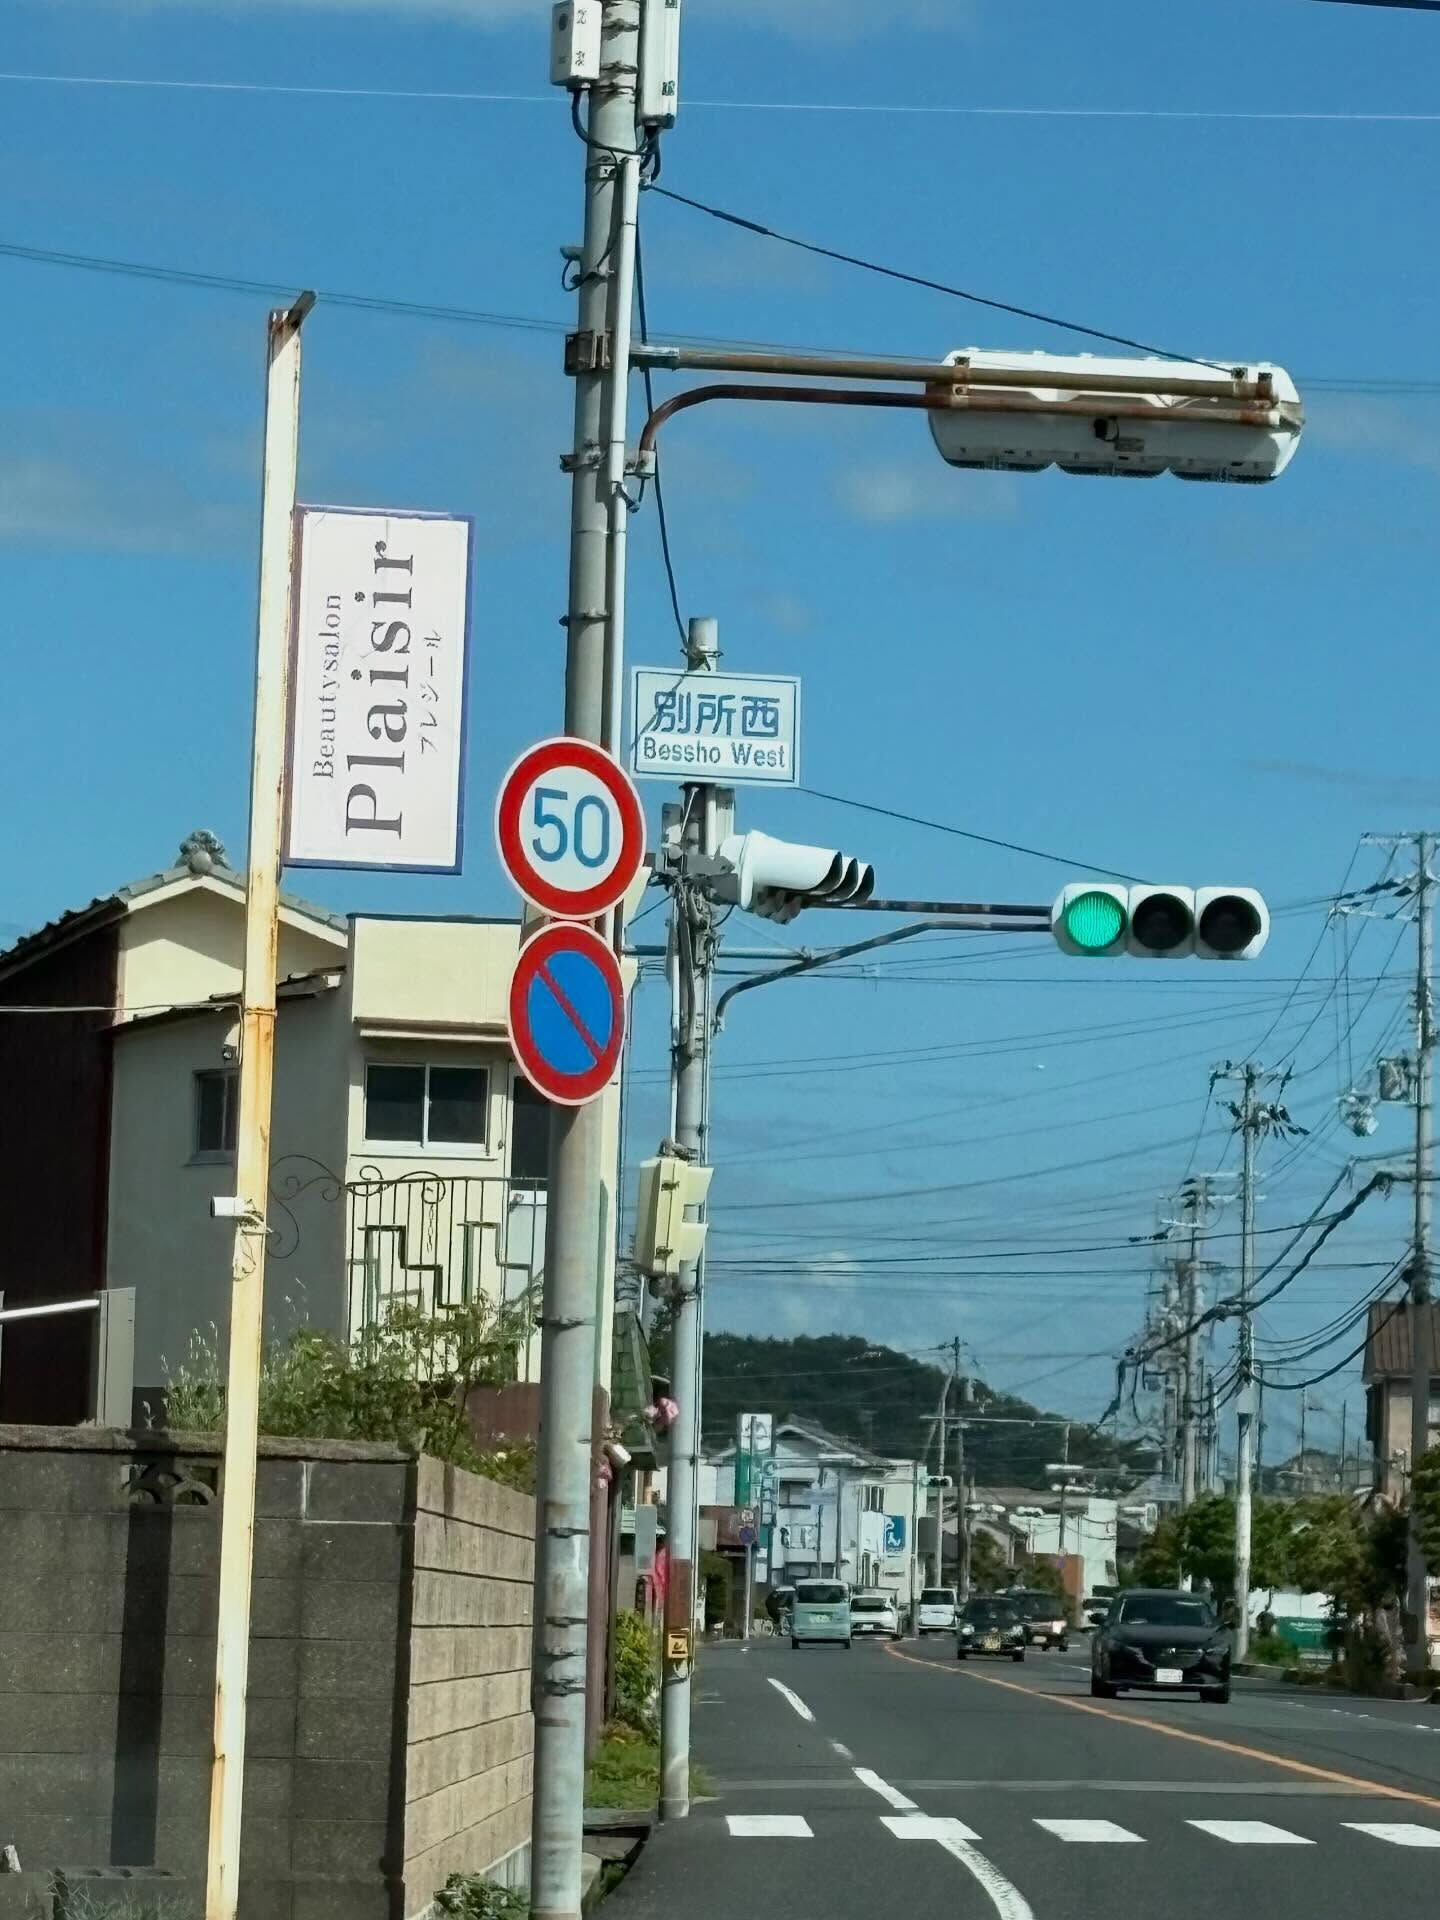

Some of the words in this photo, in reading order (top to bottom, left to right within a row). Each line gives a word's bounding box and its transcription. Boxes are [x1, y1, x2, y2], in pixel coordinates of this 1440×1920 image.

[312, 595, 341, 779] Beautysalon
[345, 540, 413, 840] Plaisir
[651, 691, 780, 738] 別所西
[644, 737, 721, 763] Bessho
[731, 742, 785, 767] West
[533, 788, 610, 868] 50
